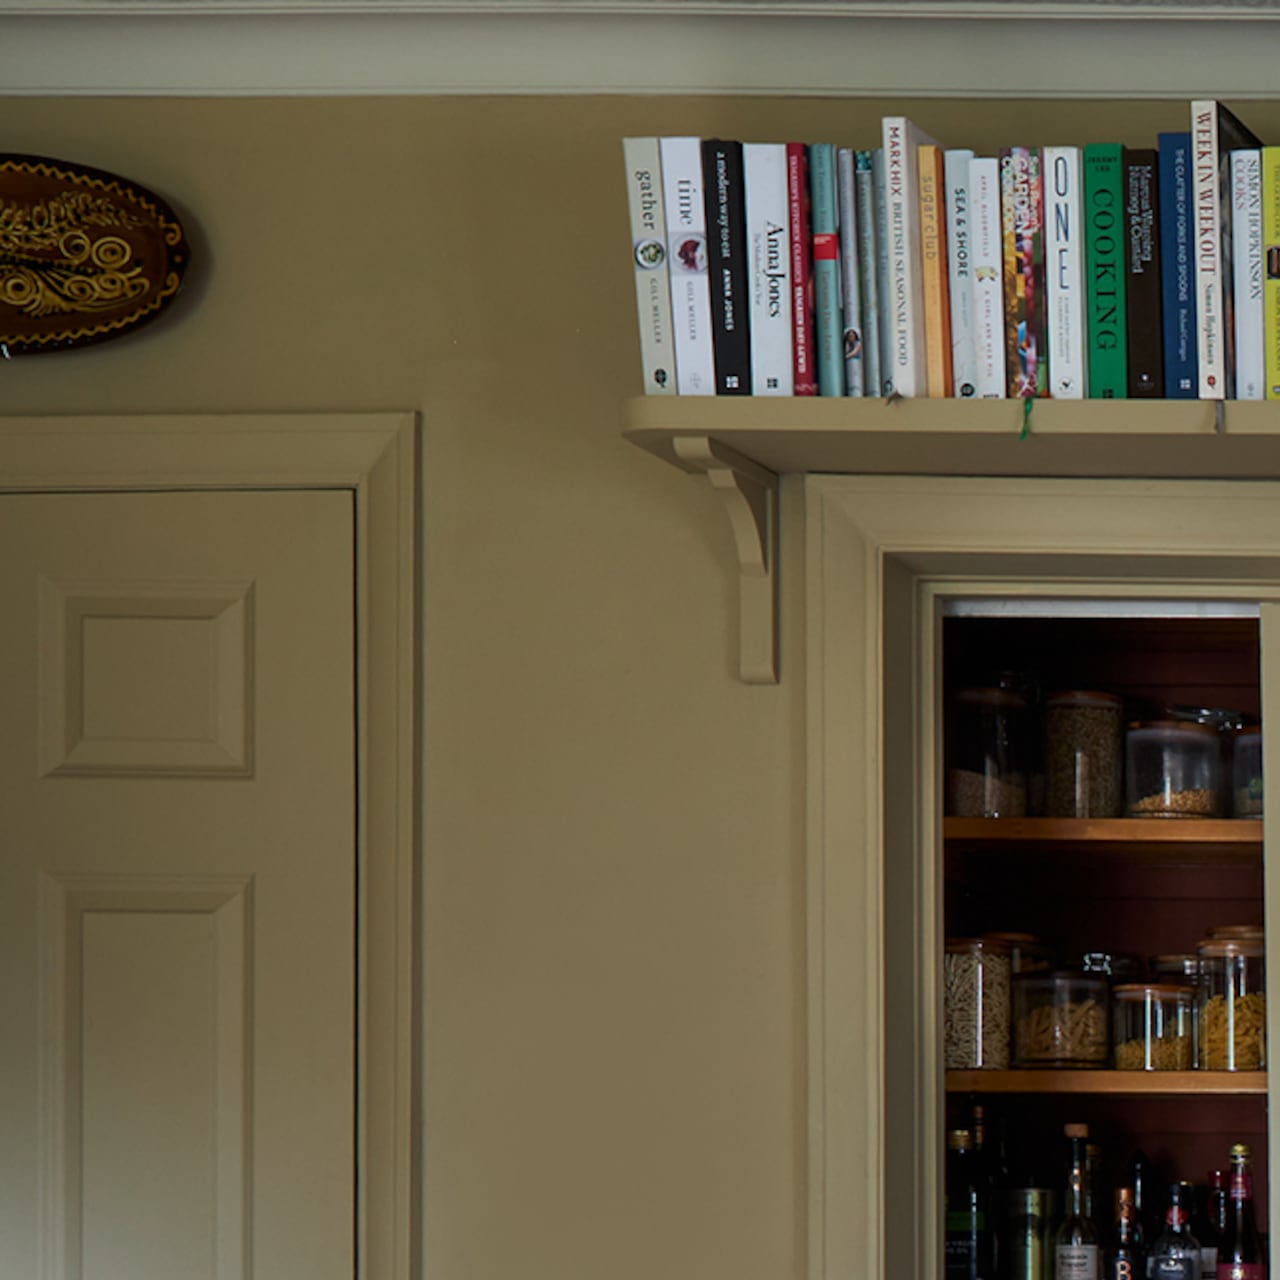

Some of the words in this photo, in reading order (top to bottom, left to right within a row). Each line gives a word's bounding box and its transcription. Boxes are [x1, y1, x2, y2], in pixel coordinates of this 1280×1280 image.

[888, 126, 900, 168] MARK
[1196, 111, 1212, 162] WEEK
[891, 170, 902, 196] HIX
[921, 175, 934, 219] sugar
[1014, 156, 1029, 234] GARDEN
[1198, 164, 1213, 184] IN
[1234, 158, 1247, 210] COOKS
[1248, 158, 1260, 209] SIMON
[636, 170, 656, 230] gather
[678, 180, 696, 225] time
[955, 188, 966, 214] SEA
[956, 217, 966, 227] &
[1199, 188, 1214, 237] WEEK
[766, 221, 784, 270] Anna
[893, 202, 904, 255] BRITISH
[925, 224, 938, 261] club
[957, 231, 968, 277] SHORE
[1092, 188, 1119, 352] COOKING
[1200, 240, 1216, 276] OUT
[1249, 212, 1262, 300] HOPKINSON
[722, 268, 732, 297] ANNA
[763, 270, 786, 318] Jones
[894, 258, 906, 326] SEASONAL
[1204, 282, 1215, 313] Simon
[724, 299, 734, 331] JONES
[898, 328, 908, 366] FOOD
[1203, 316, 1218, 365] Hopkinson
